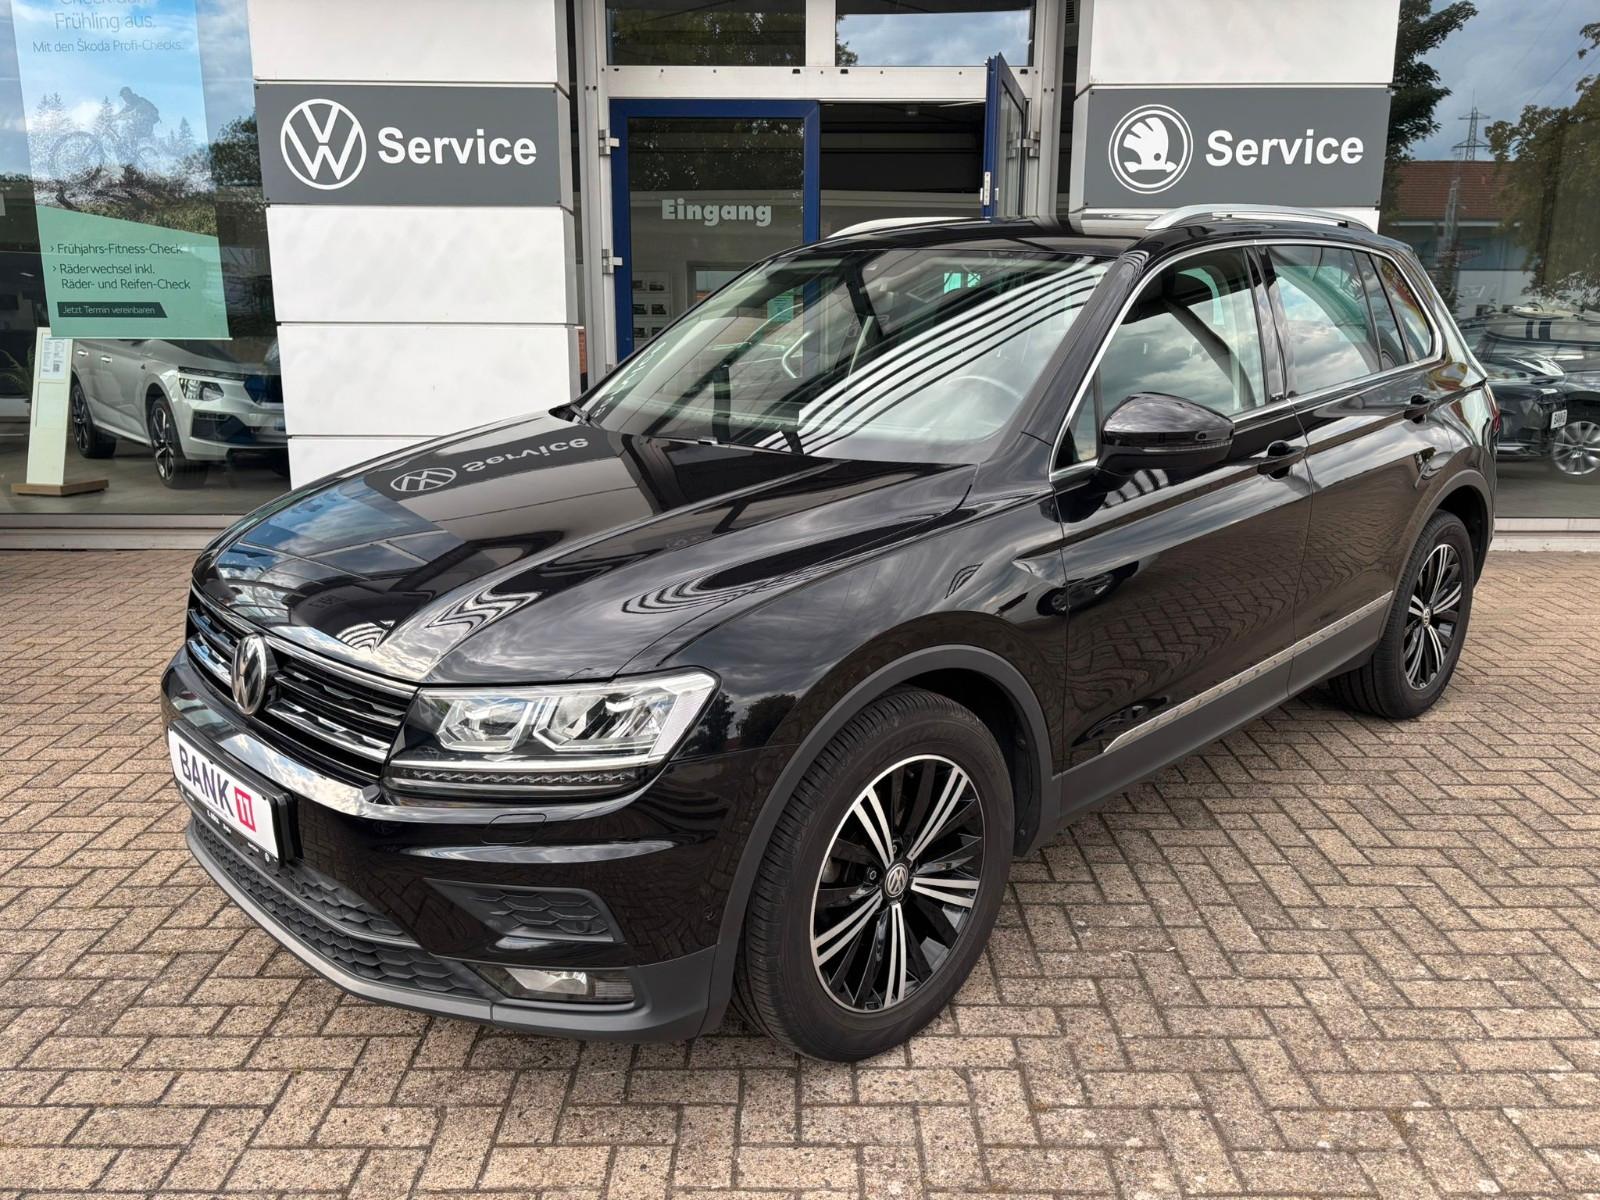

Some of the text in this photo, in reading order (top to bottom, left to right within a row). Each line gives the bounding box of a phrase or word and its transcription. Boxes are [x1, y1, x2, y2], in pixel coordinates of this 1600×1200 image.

[55, 12, 157, 32] Frühling aus.
[33, 41, 50, 52] Mit
[54, 41, 73, 52] den
[77, 38, 110, 52] Škoda
[377, 126, 537, 165] Service
[1205, 129, 1364, 167] Service
[662, 198, 772, 226] Eingang
[57, 243, 183, 256] Frühjahrs-Fitness-Check
[60, 263, 155, 274] Räderwechsel inkl.
[62, 278, 191, 290] Räder- und Reifen-Check
[62, 305, 155, 314] Jetzt Termin vereinbaren
[178, 743, 235, 818] BANK
